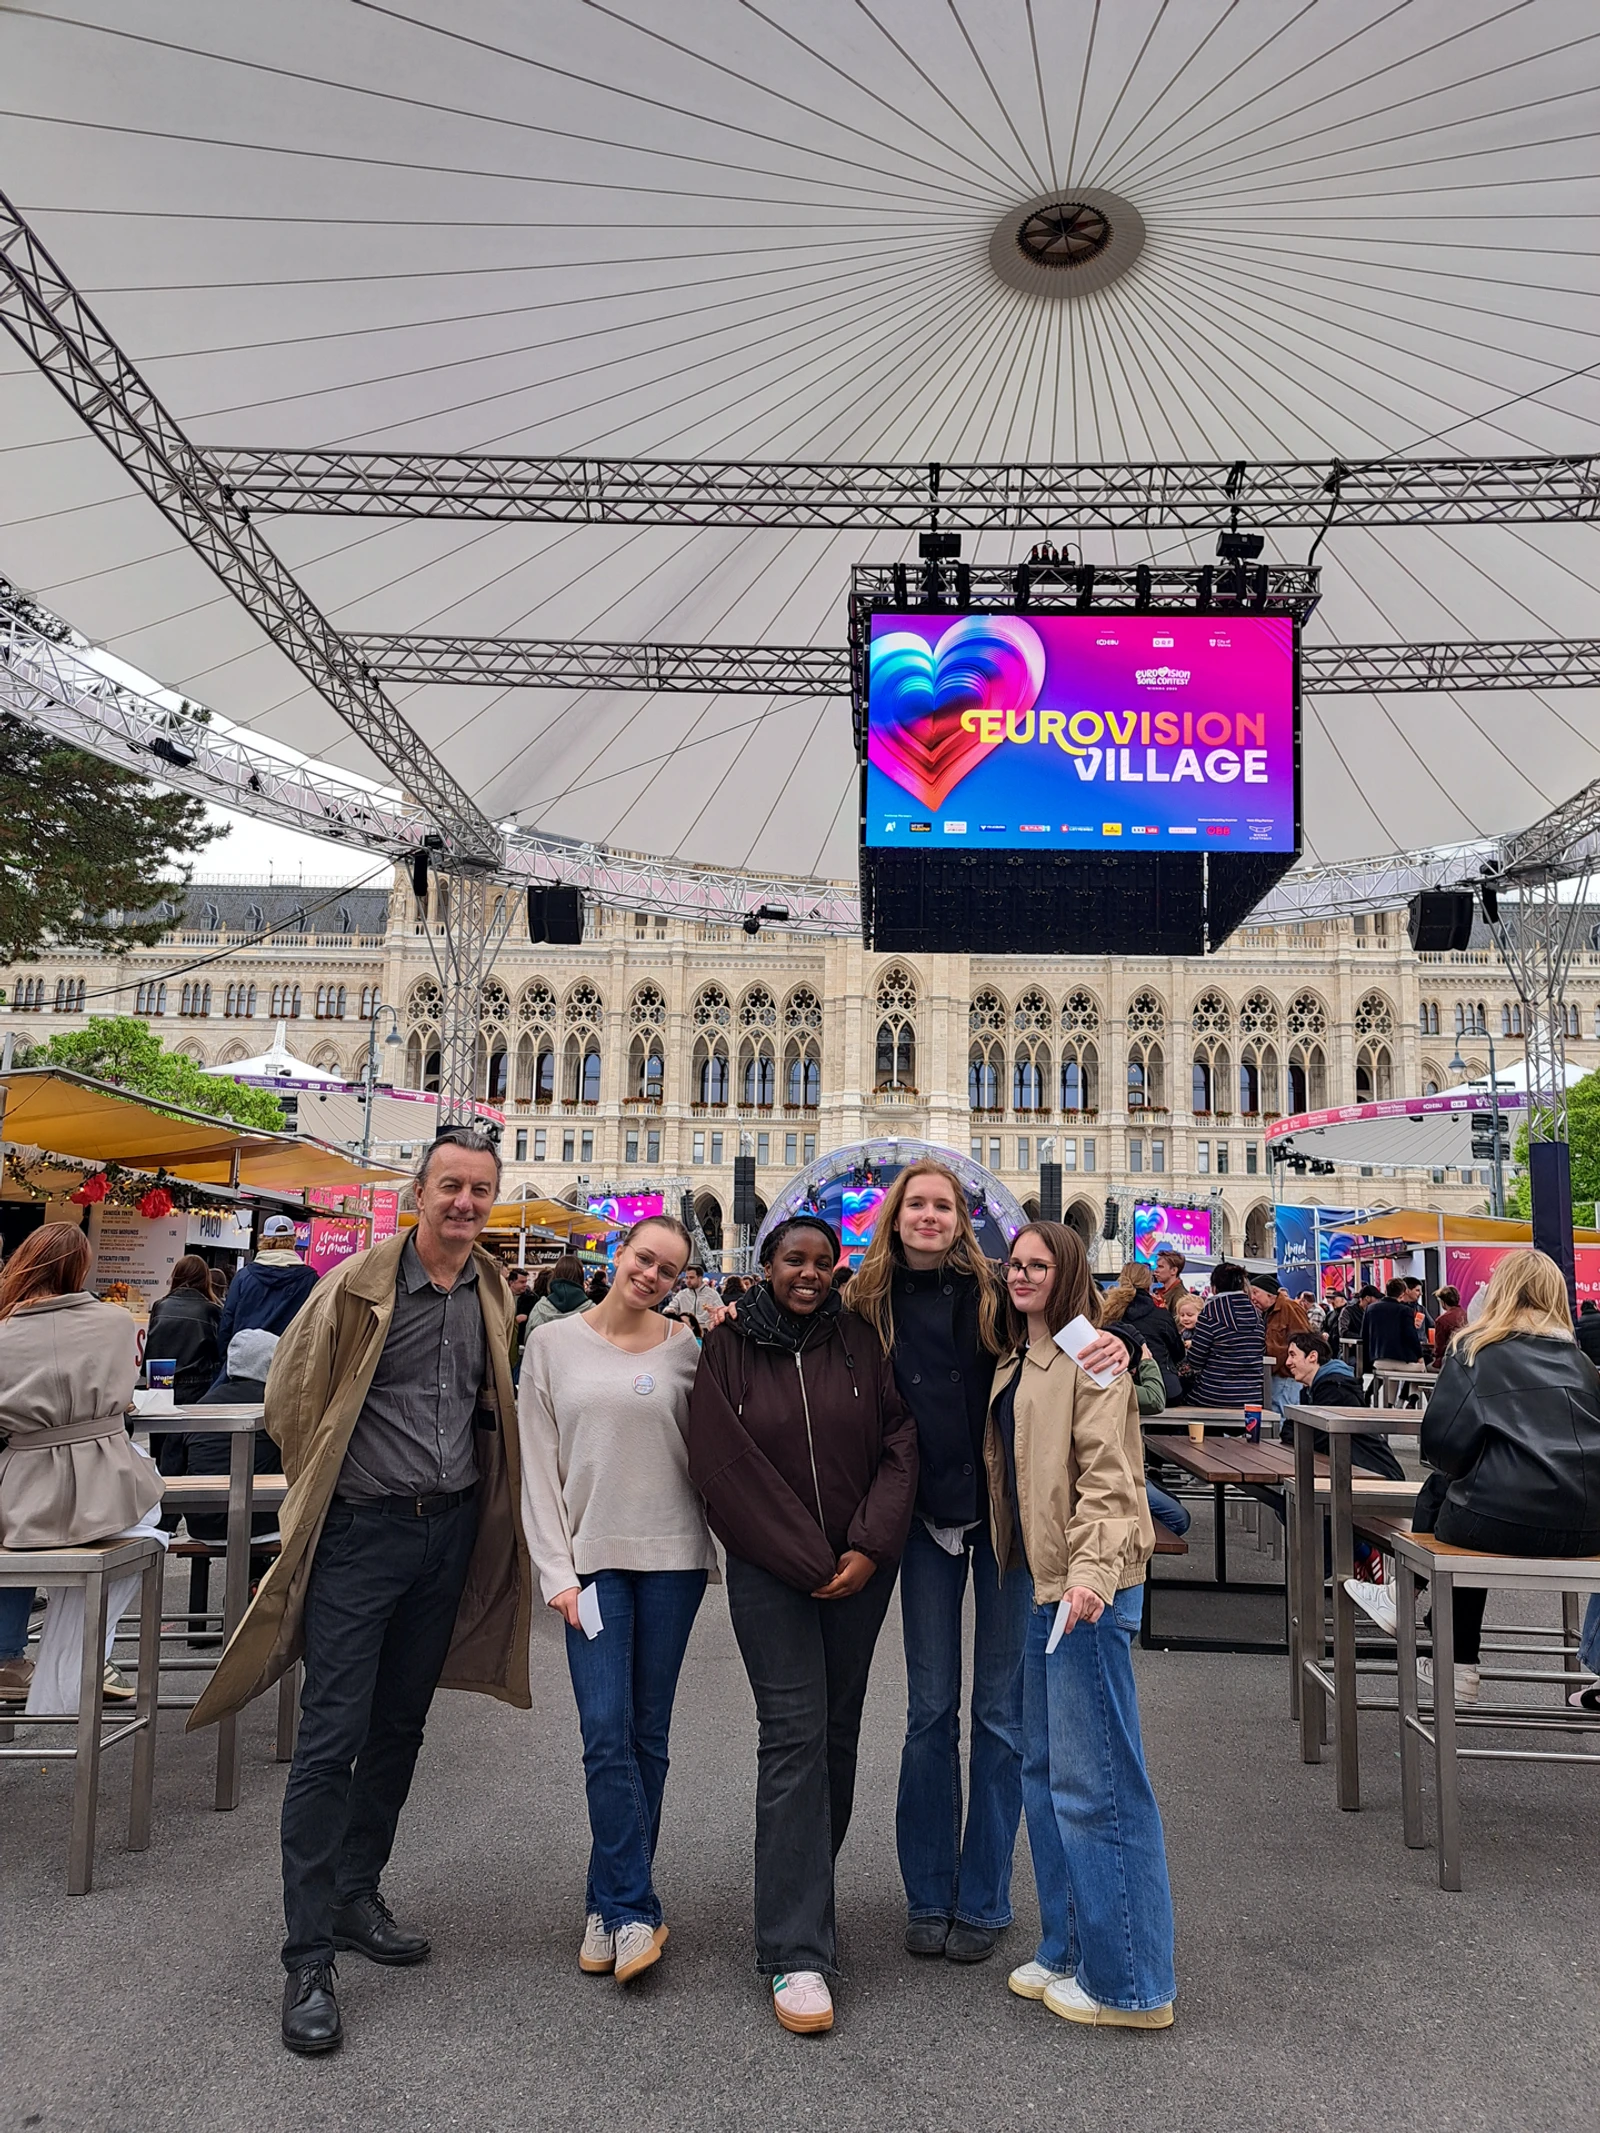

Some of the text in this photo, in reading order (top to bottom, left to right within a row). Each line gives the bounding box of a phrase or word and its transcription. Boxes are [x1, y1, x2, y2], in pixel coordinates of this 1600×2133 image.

[960, 709, 1265, 756] EUROVISION
[1073, 747, 1268, 783] VILLAGE
[200, 1215, 222, 1238] PACO
[320, 1231, 350, 1243] United
[315, 1242, 354, 1256] by Music
